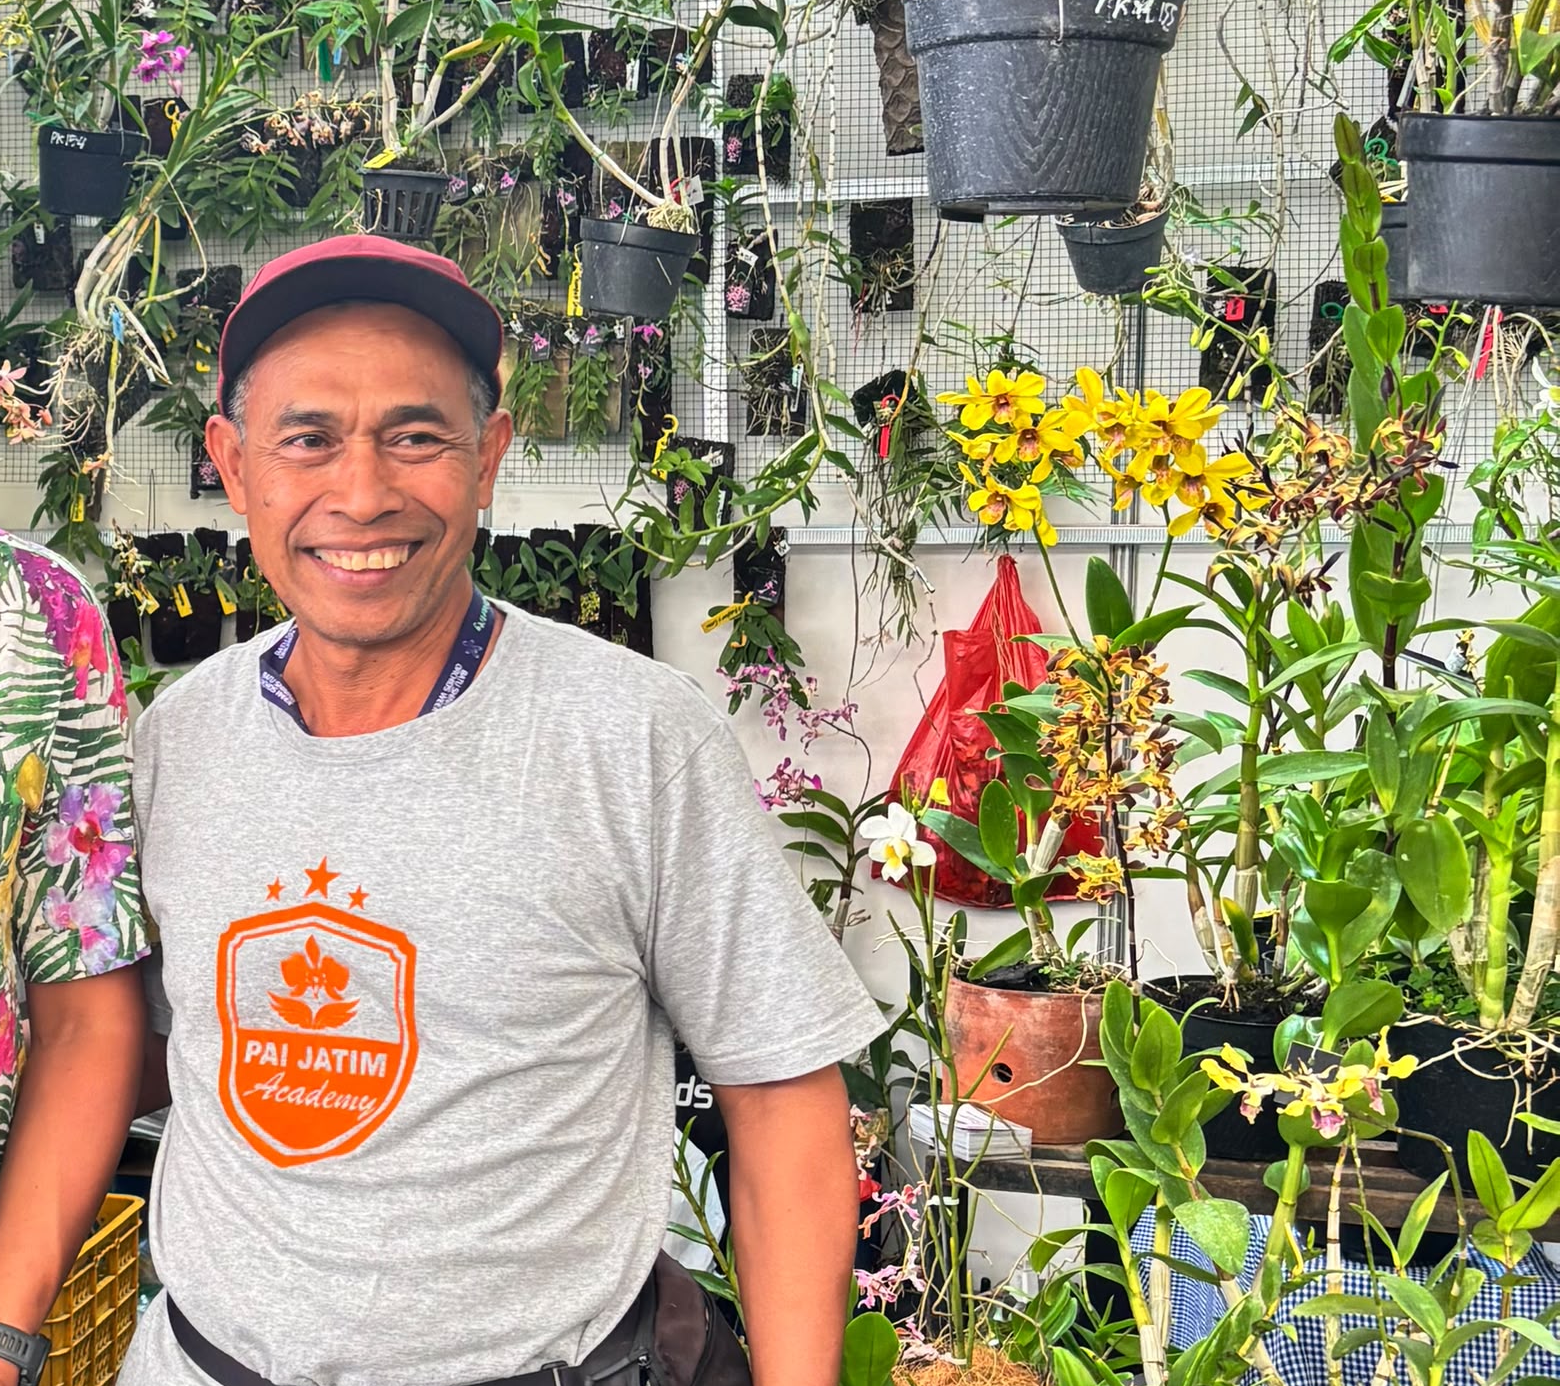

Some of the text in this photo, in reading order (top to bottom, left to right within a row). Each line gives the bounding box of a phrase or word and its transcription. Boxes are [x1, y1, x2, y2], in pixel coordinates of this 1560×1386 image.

[243, 1039, 388, 1078] PAI JATIM
[242, 1071, 377, 1121] Academy
